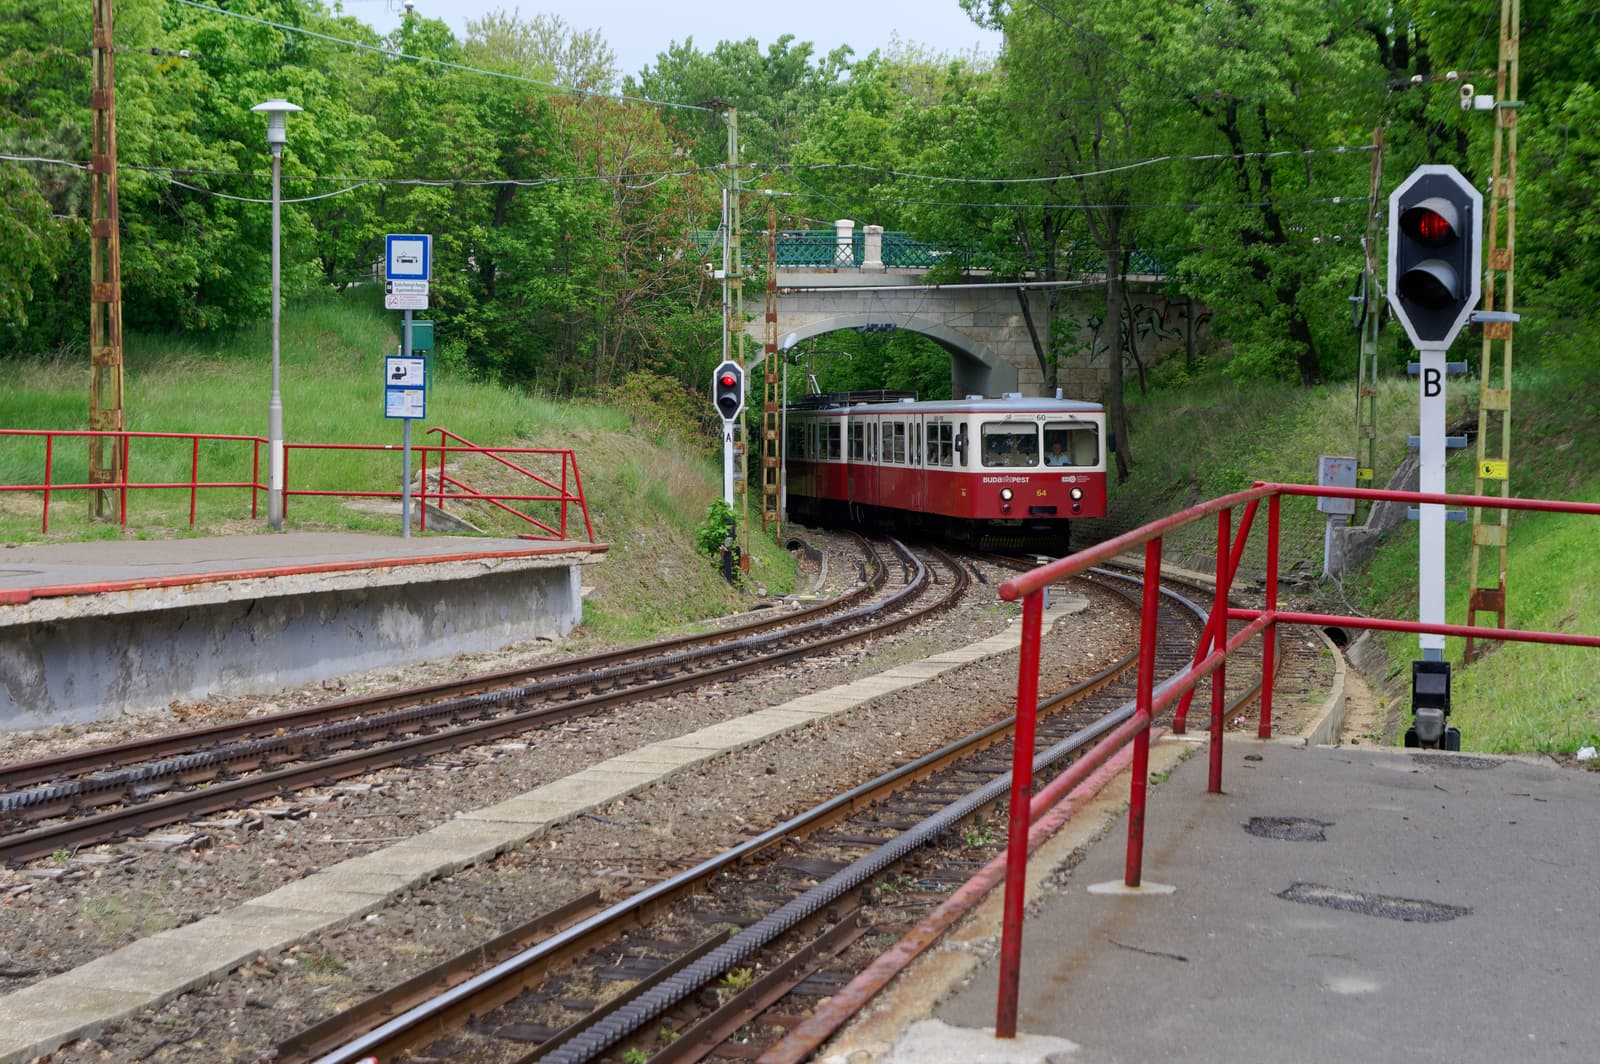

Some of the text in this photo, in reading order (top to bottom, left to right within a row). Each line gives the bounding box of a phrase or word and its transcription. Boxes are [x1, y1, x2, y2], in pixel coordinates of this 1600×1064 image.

[1424, 368, 1442, 397] B
[726, 432, 732, 443] A
[1036, 489, 1047, 497] 64
